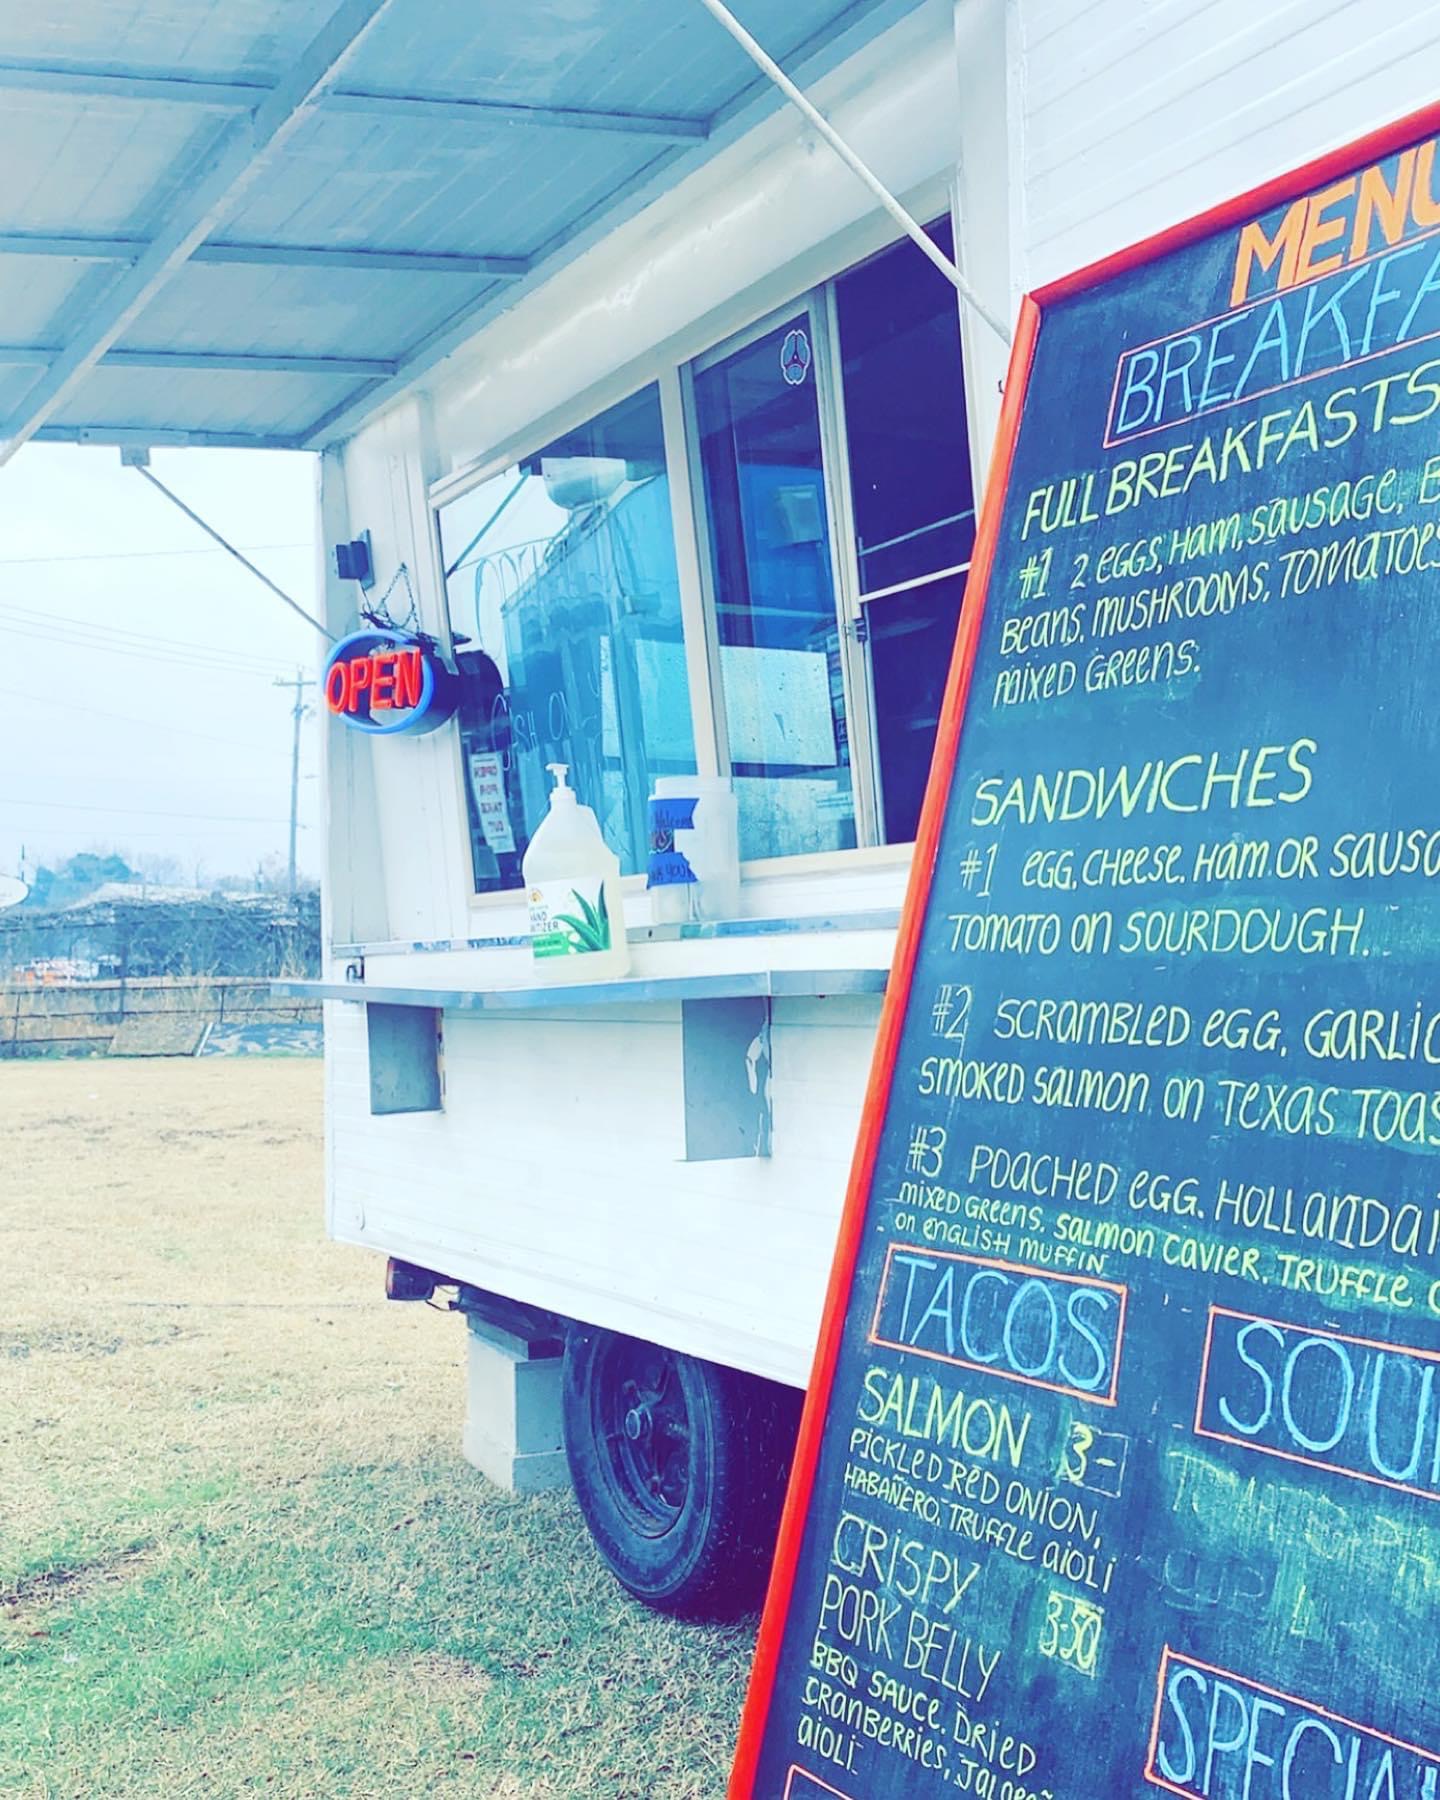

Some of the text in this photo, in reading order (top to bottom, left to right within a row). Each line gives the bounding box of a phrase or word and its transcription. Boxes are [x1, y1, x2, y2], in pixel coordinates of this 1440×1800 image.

[1021, 355, 1440, 541] FULL BREAKFASTS
[1019, 546, 1054, 600] #1
[1070, 553, 1090, 590] 2
[324, 646, 421, 715] OPEN
[971, 738, 1318, 827] SANDWICHES
[960, 843, 998, 898] #1
[1276, 836, 1319, 880] OR
[1119, 907, 1370, 957] SOURDOUGH.
[932, 985, 972, 1039] #2
[908, 1126, 947, 1178] #3
[894, 1254, 1110, 1392] TACOS
[858, 1367, 1032, 1467] SALMON
[1218, 1321, 1440, 1485] SOU
[832, 1511, 981, 1614] CRiSPY
[810, 1641, 858, 1689] BBQ
[818, 1573, 902, 1661] PORK
[904, 1611, 1001, 1702] BELLY
